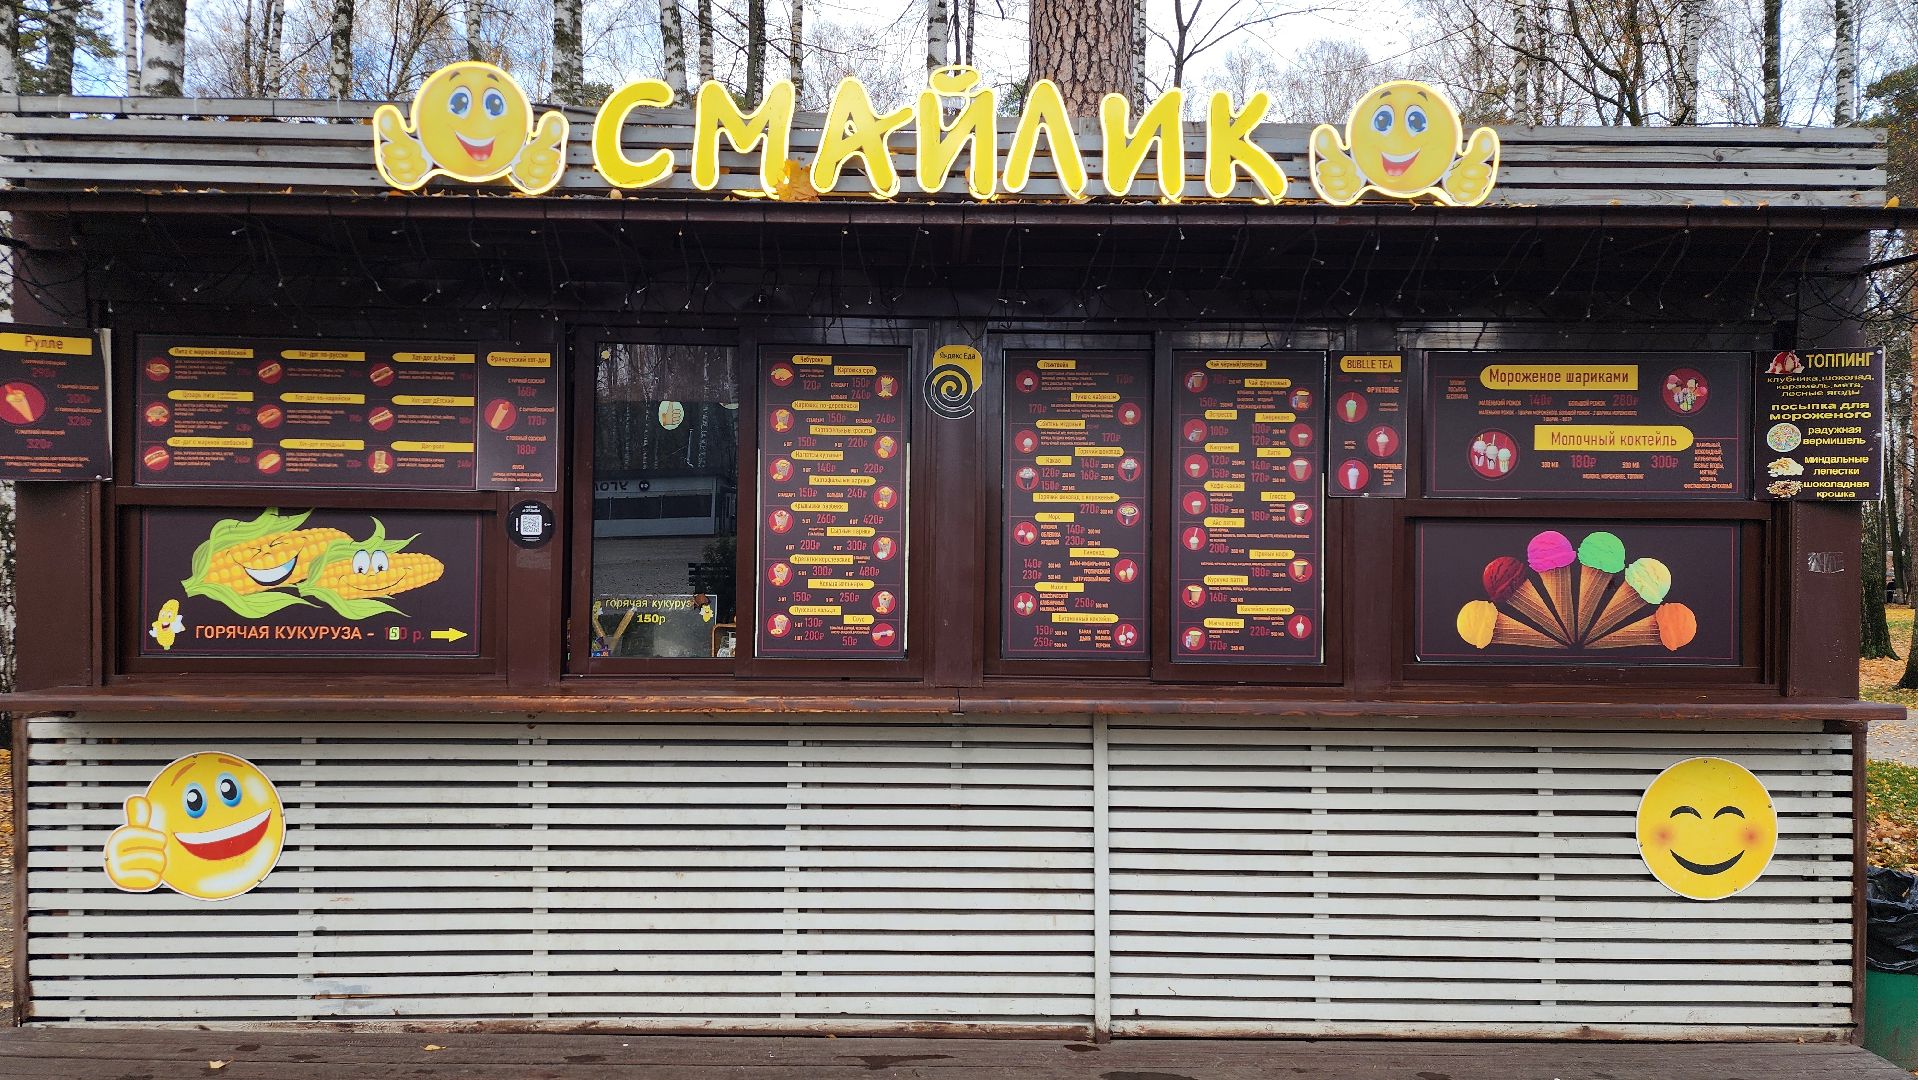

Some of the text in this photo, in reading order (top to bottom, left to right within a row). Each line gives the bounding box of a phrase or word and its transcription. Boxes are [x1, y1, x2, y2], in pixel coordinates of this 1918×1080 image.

[592, 65, 1289, 204] СМАЙЛИК
[24, 334, 64, 351] Рулле
[940, 352, 976, 360] Яндекс Еда
[1806, 352, 1875, 369] ТОППИНГ
[1347, 359, 1393, 369] BUBLLE TEA
[1489, 368, 1629, 387] Мороженое шариками
[1367, 386, 1400, 394] ФРУКТОВЫЕ
[1826, 389, 1860, 397] ягоды
[1771, 402, 1870, 411] посыпка для
[1769, 411, 1872, 422] мороженого
[1808, 426, 1862, 436] радужная
[1551, 431, 1678, 447] Молочный коктейль
[1803, 437, 1867, 447] вермишель
[1804, 456, 1869, 465] миндальные
[1813, 467, 1860, 476] лепестки
[1816, 490, 1856, 499] крошка
[605, 599, 648, 609] горячая
[636, 614, 666, 626] 150р
[195, 625, 269, 640] ГОРЯЧАЯ
[274, 625, 362, 641] КУКУРУЗА
[412, 631, 425, 643] р.
